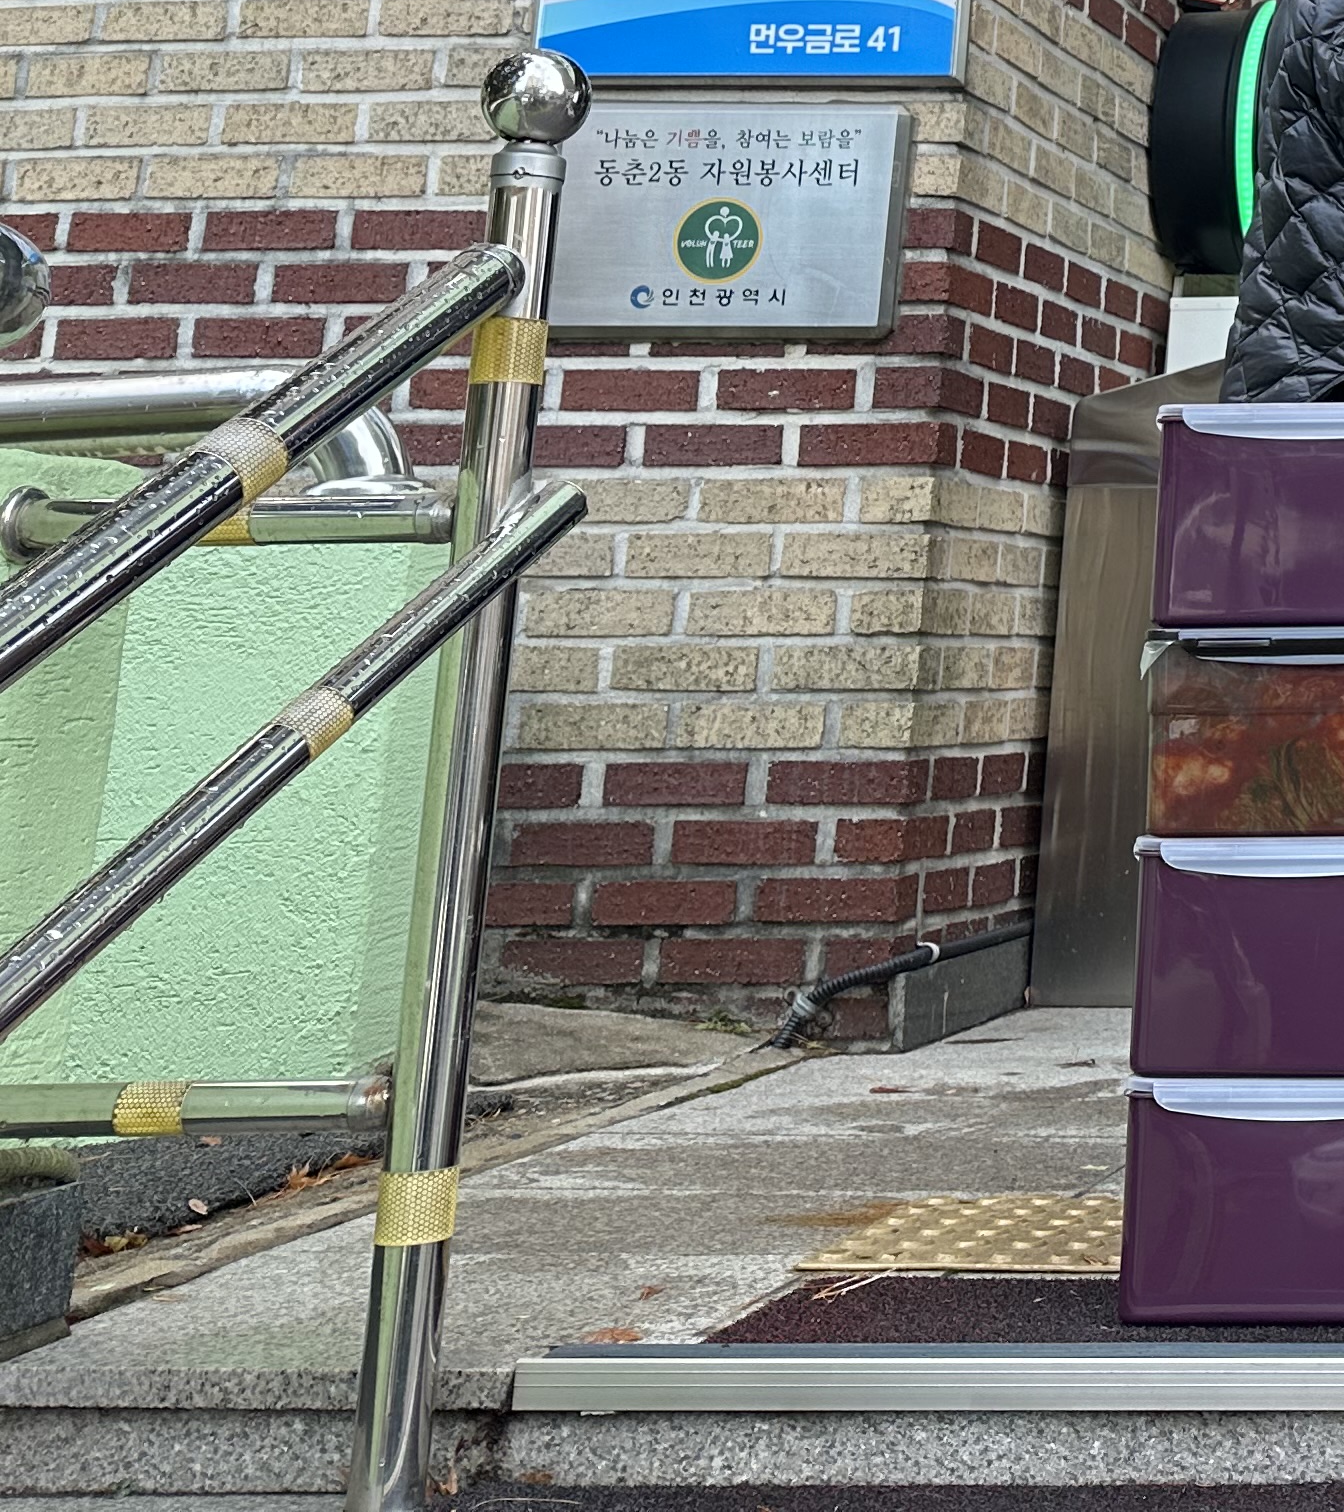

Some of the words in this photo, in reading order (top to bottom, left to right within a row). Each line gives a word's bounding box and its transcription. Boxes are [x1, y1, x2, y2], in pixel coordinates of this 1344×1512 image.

[749, 23, 861, 54] 먼우금로
[867, 27, 900, 53] 41
[736, 128, 791, 149] 참여는
[594, 159, 689, 187] 동춘2동
[700, 158, 859, 187] 자원봉사센터
[661, 287, 787, 306] 인천광역시
